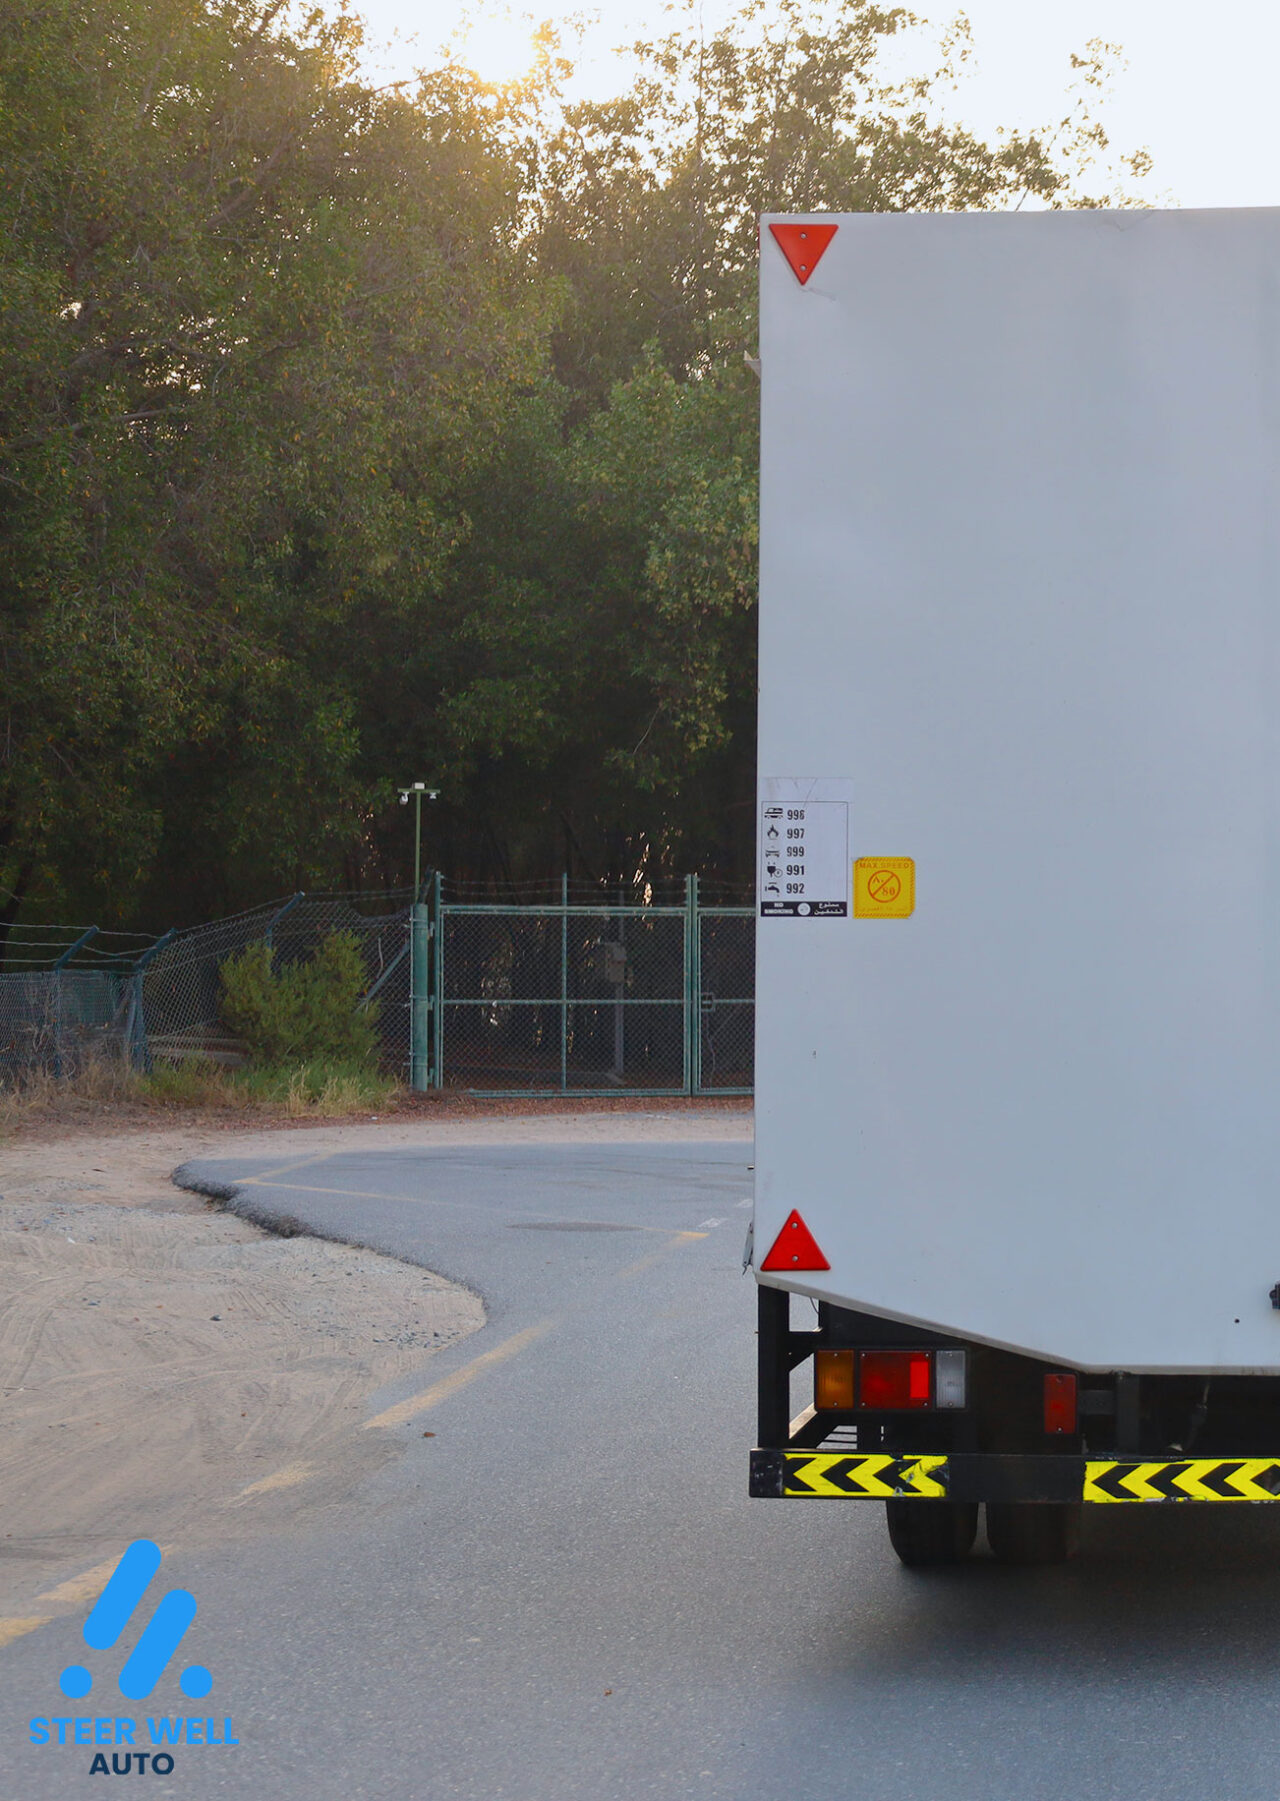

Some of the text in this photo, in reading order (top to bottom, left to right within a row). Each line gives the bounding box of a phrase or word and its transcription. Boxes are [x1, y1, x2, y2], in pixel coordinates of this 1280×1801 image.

[787, 828, 805, 839] 997
[786, 846, 805, 857] 999
[786, 865, 805, 876] 991
[786, 883, 805, 894] 992
[882, 886, 896, 896] 80
